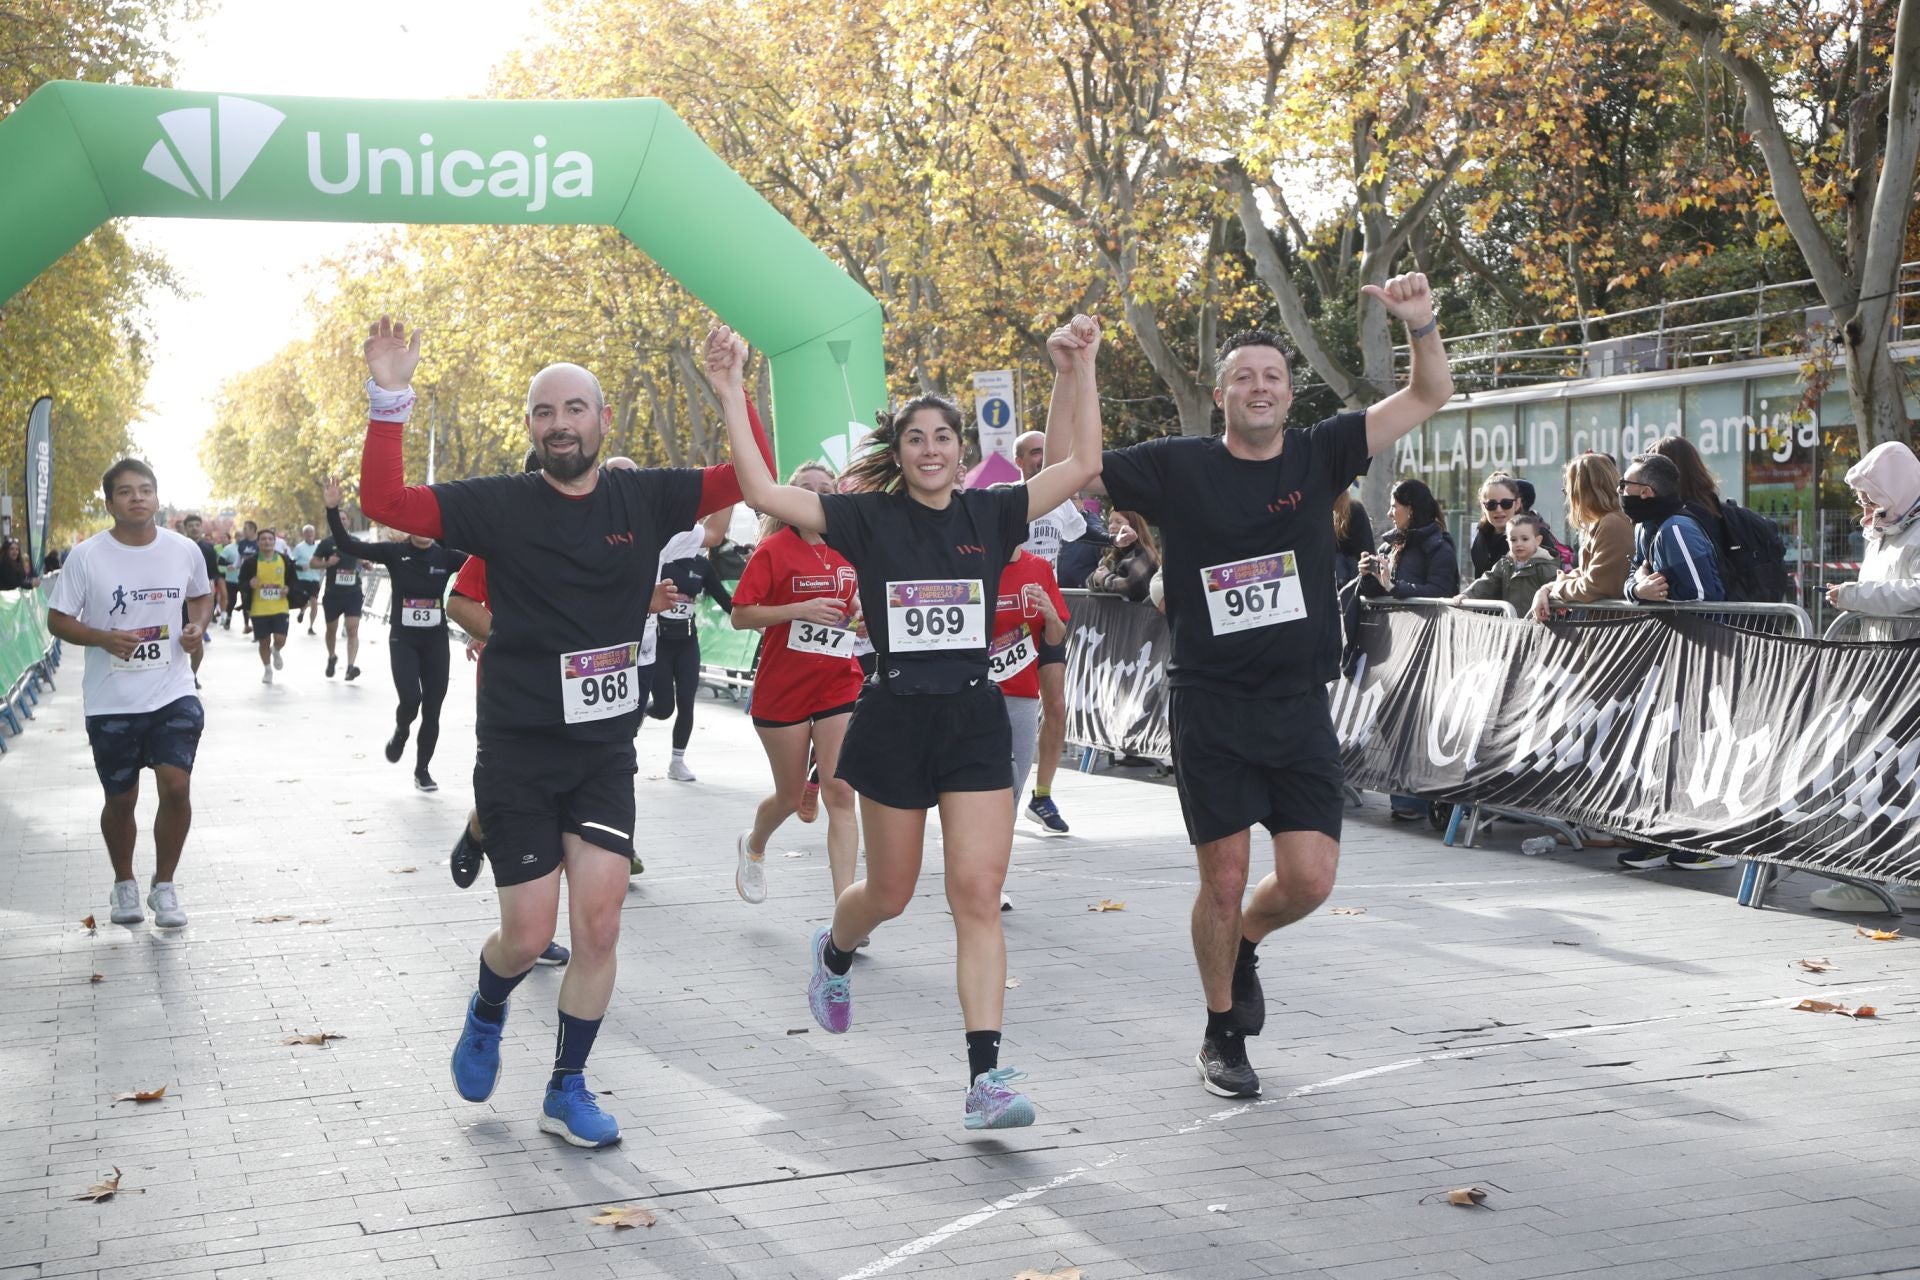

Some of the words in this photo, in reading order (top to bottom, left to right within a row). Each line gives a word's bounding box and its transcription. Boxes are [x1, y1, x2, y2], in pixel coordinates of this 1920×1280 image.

[306, 131, 593, 212] Unicaja
[1573, 408, 1682, 461] ciudad
[1699, 399, 1820, 463] amiga
[906, 586, 918, 599] 9ª
[1225, 580, 1281, 617] 967
[412, 610, 431, 622] 63
[905, 606, 965, 637] 969
[798, 623, 846, 649] 347
[124, 642, 161, 662] 48
[988, 643, 1028, 674] 348
[581, 671, 629, 706] 968
[1685, 684, 1772, 820] de
